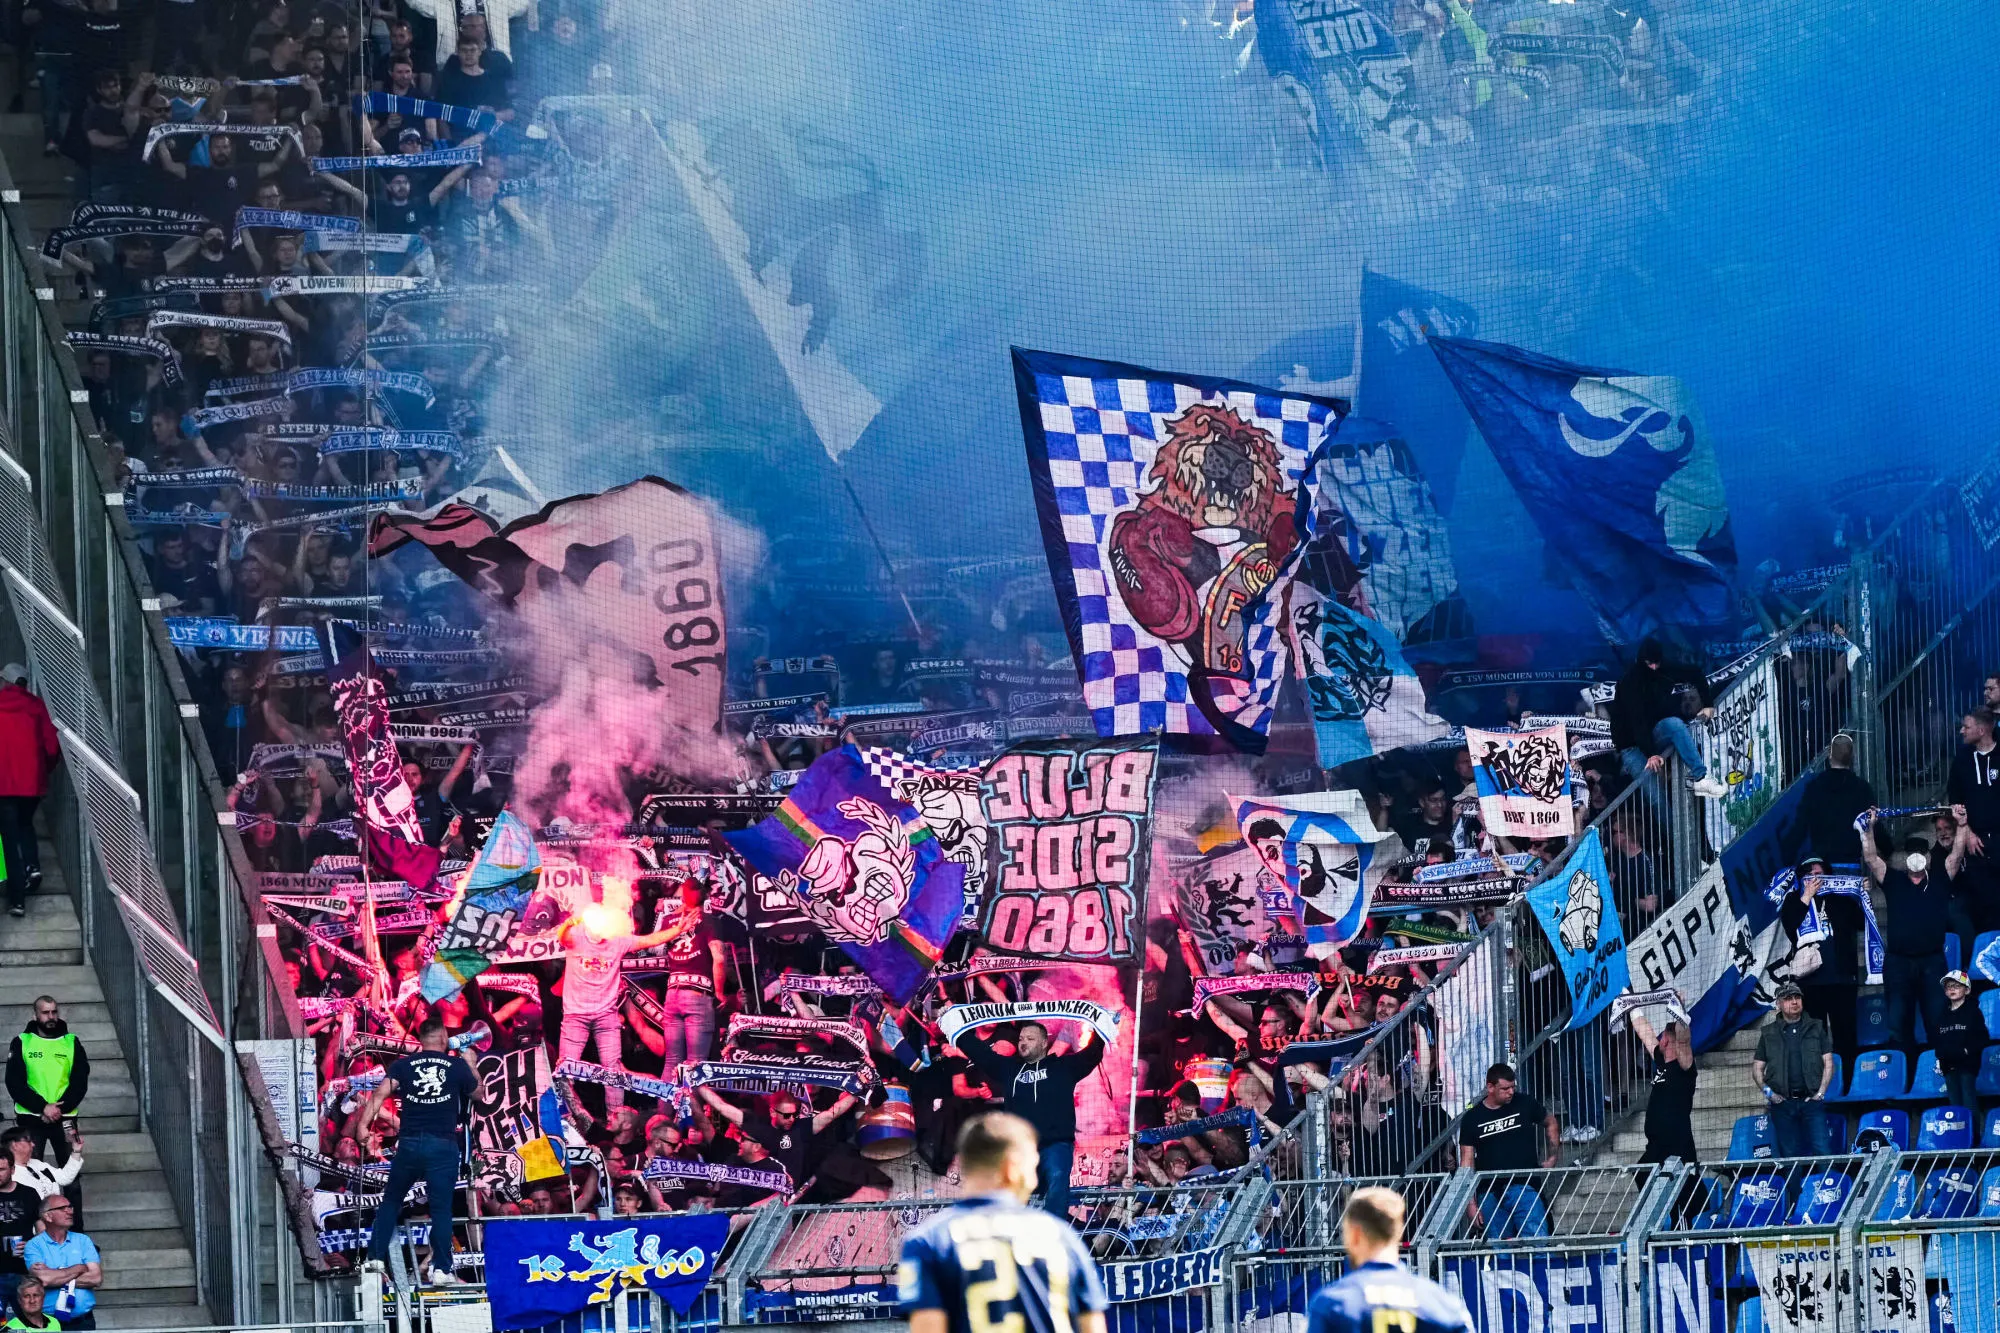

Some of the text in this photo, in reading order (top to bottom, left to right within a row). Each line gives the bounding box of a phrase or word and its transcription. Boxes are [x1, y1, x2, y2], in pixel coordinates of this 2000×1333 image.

[97, 204, 134, 214] VEREIN
[279, 424, 329, 434] STEH'N
[326, 481, 400, 499] MÜNCHEN
[651, 539, 728, 677] 1860
[231, 627, 319, 645] VIKINGS
[1467, 674, 1484, 682] TSV
[1486, 671, 1532, 681] MÜNCHEN
[1535, 670, 1556, 680] VON
[774, 698, 797, 707] 1860
[430, 727, 463, 739] 1860
[1503, 810, 1560, 825] BBF 1860
[260, 876, 287, 888] 1860
[1387, 880, 1513, 897] SECHZIG MÜNCHEN
[1378, 954, 1402, 963] TSV
[1405, 948, 1437, 958] 1860
[959, 1003, 1016, 1025] LEONUM
[1035, 1000, 1102, 1023] MÜNCHEN
[28, 1051, 43, 1060] 265
[803, 1053, 861, 1068] Finest
[410, 1057, 452, 1068] MEIN VEREIN
[406, 1094, 451, 1104] FÜR ALLE ZEIT
[518, 1245, 706, 1283] 18 60
